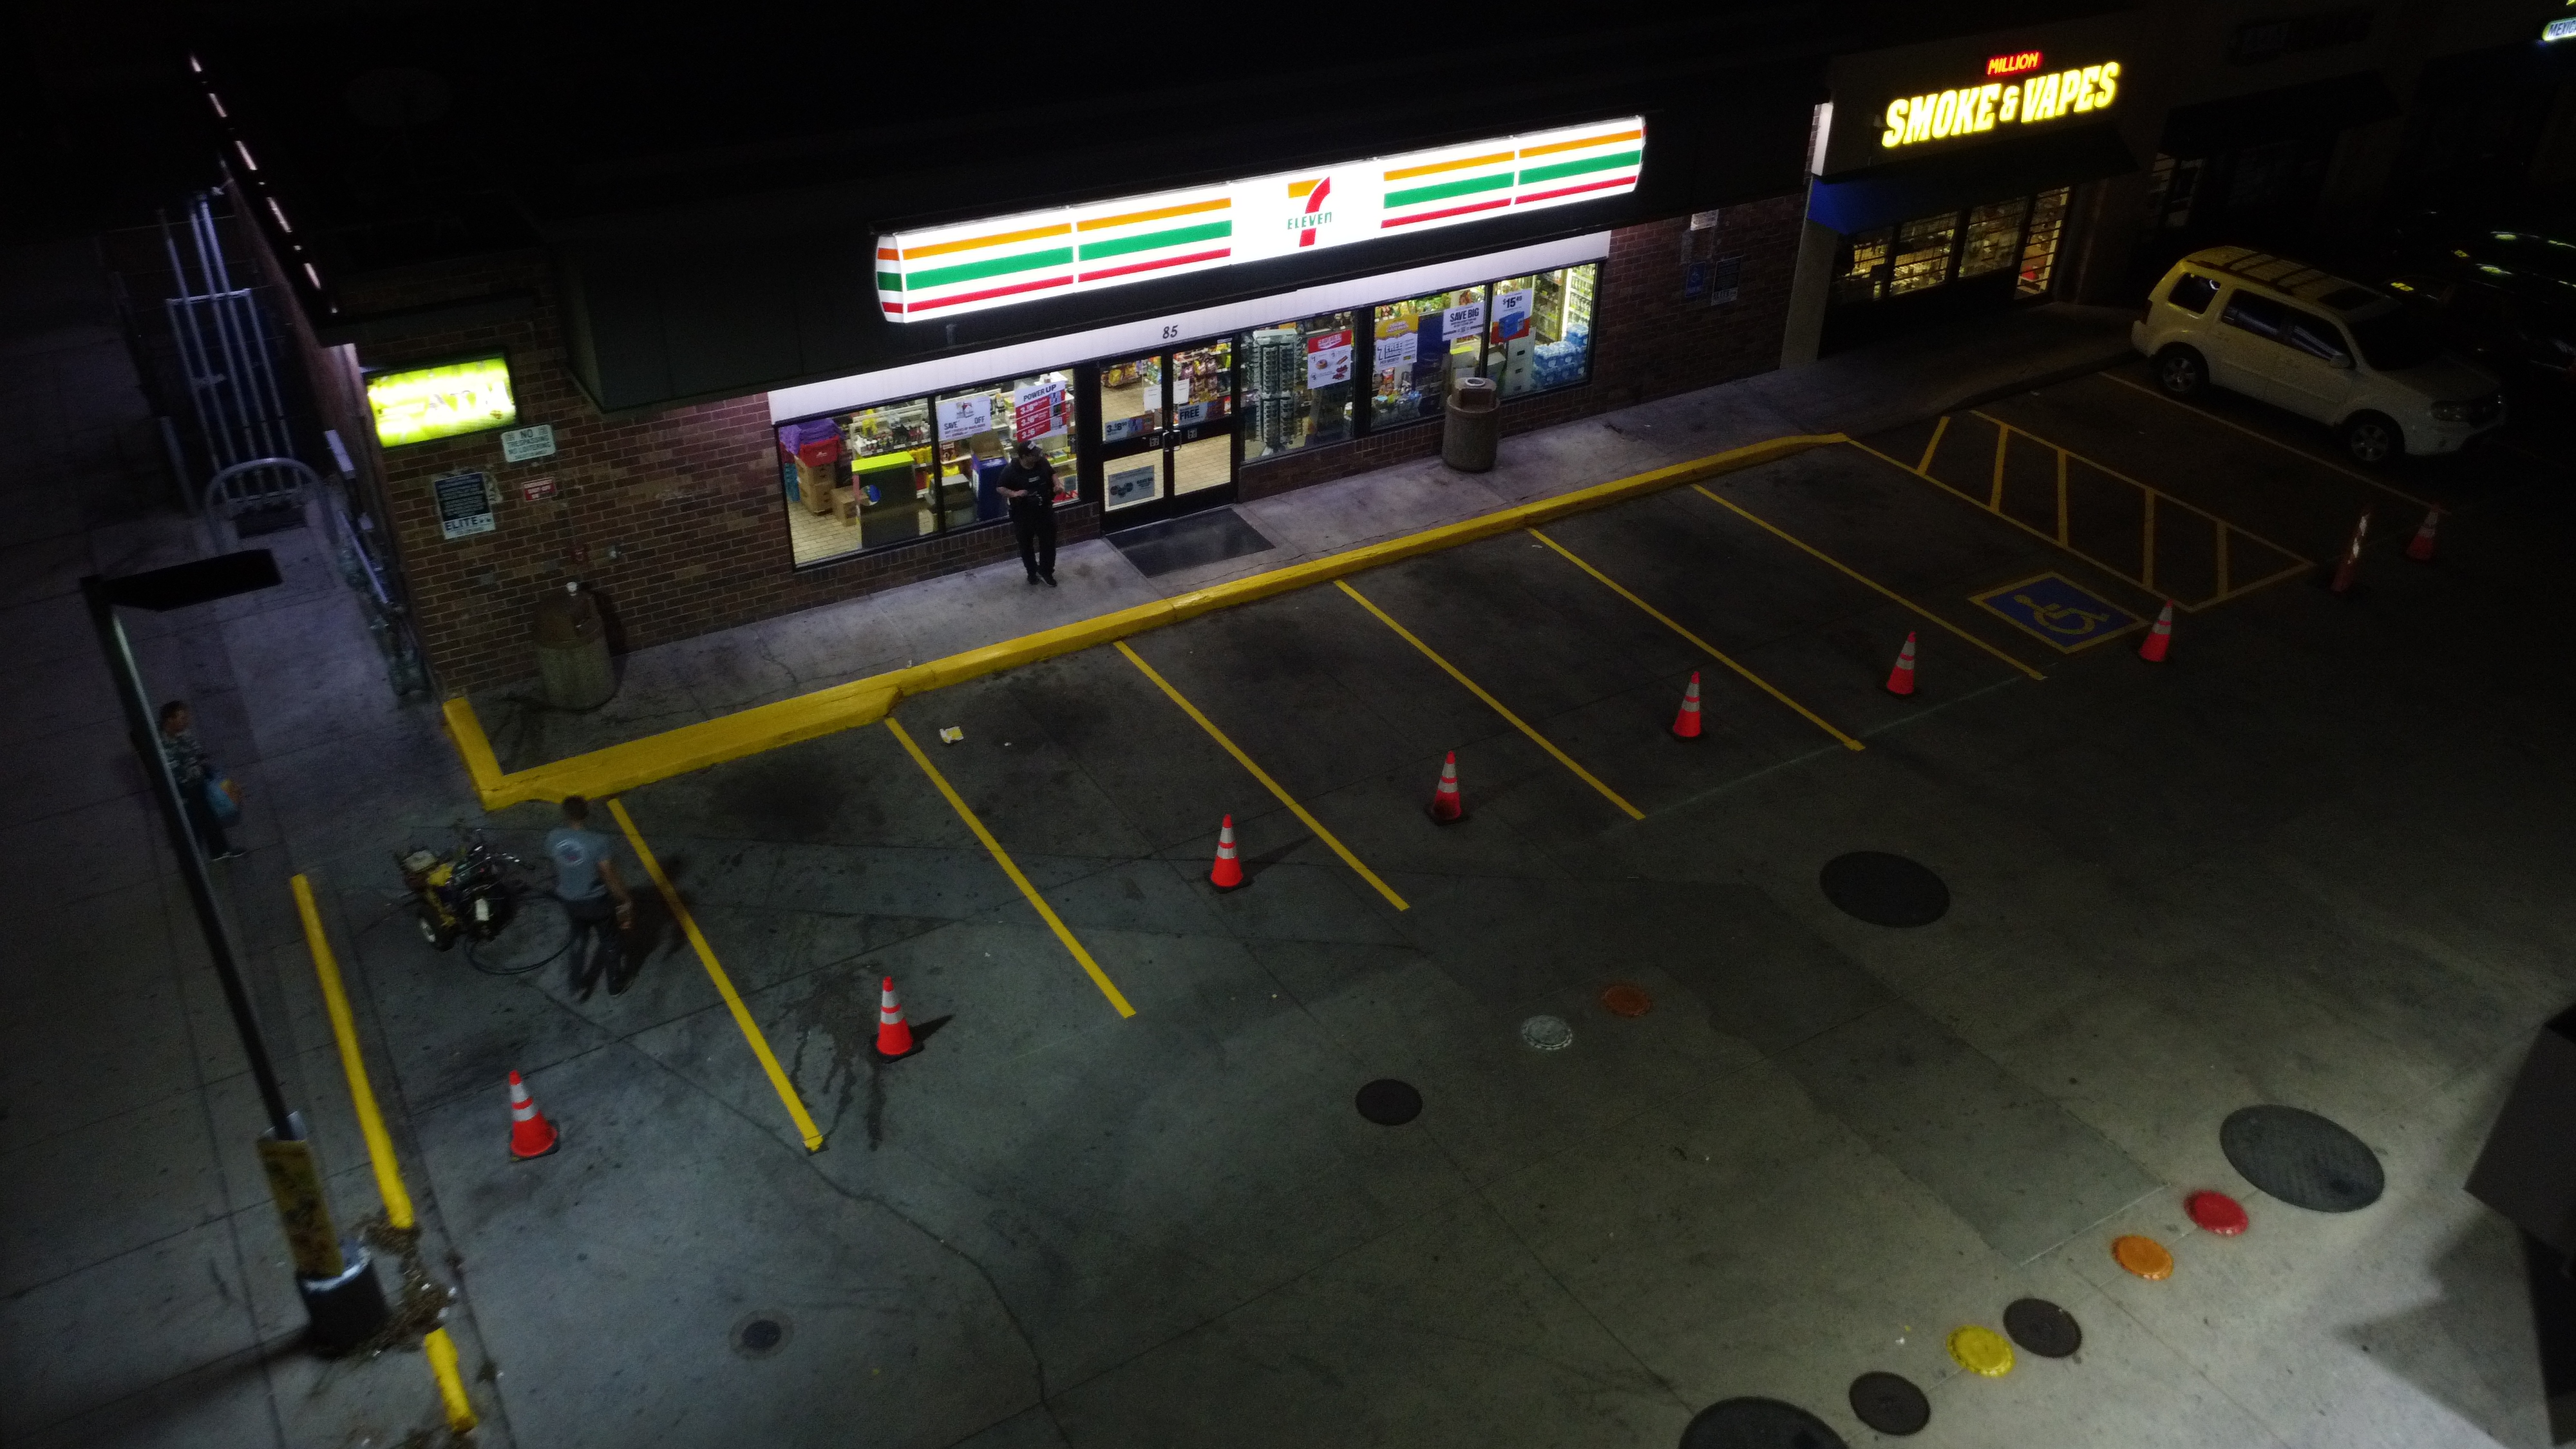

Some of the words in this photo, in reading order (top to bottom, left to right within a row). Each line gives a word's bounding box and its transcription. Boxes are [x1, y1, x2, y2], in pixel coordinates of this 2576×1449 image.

[2547, 20, 2576, 37] MEXIC
[1987, 52, 2040, 75] MILLION
[1882, 83, 2002, 148] SMOKE
[2000, 85, 2020, 122] &
[2021, 61, 2120, 123] VAPES
[1288, 176, 1331, 248] 7
[1450, 310, 1467, 322] SAVE
[1468, 308, 1480, 318] BIG
[1162, 325, 1179, 339] 85
[1023, 388, 1045, 402] POWER
[1046, 384, 1057, 393] UP
[1180, 408, 1200, 421] FREE
[944, 421, 958, 430] SAVE
[974, 416, 985, 424] OFF
[520, 429, 533, 439] NO
[444, 516, 478, 531] ELITE
